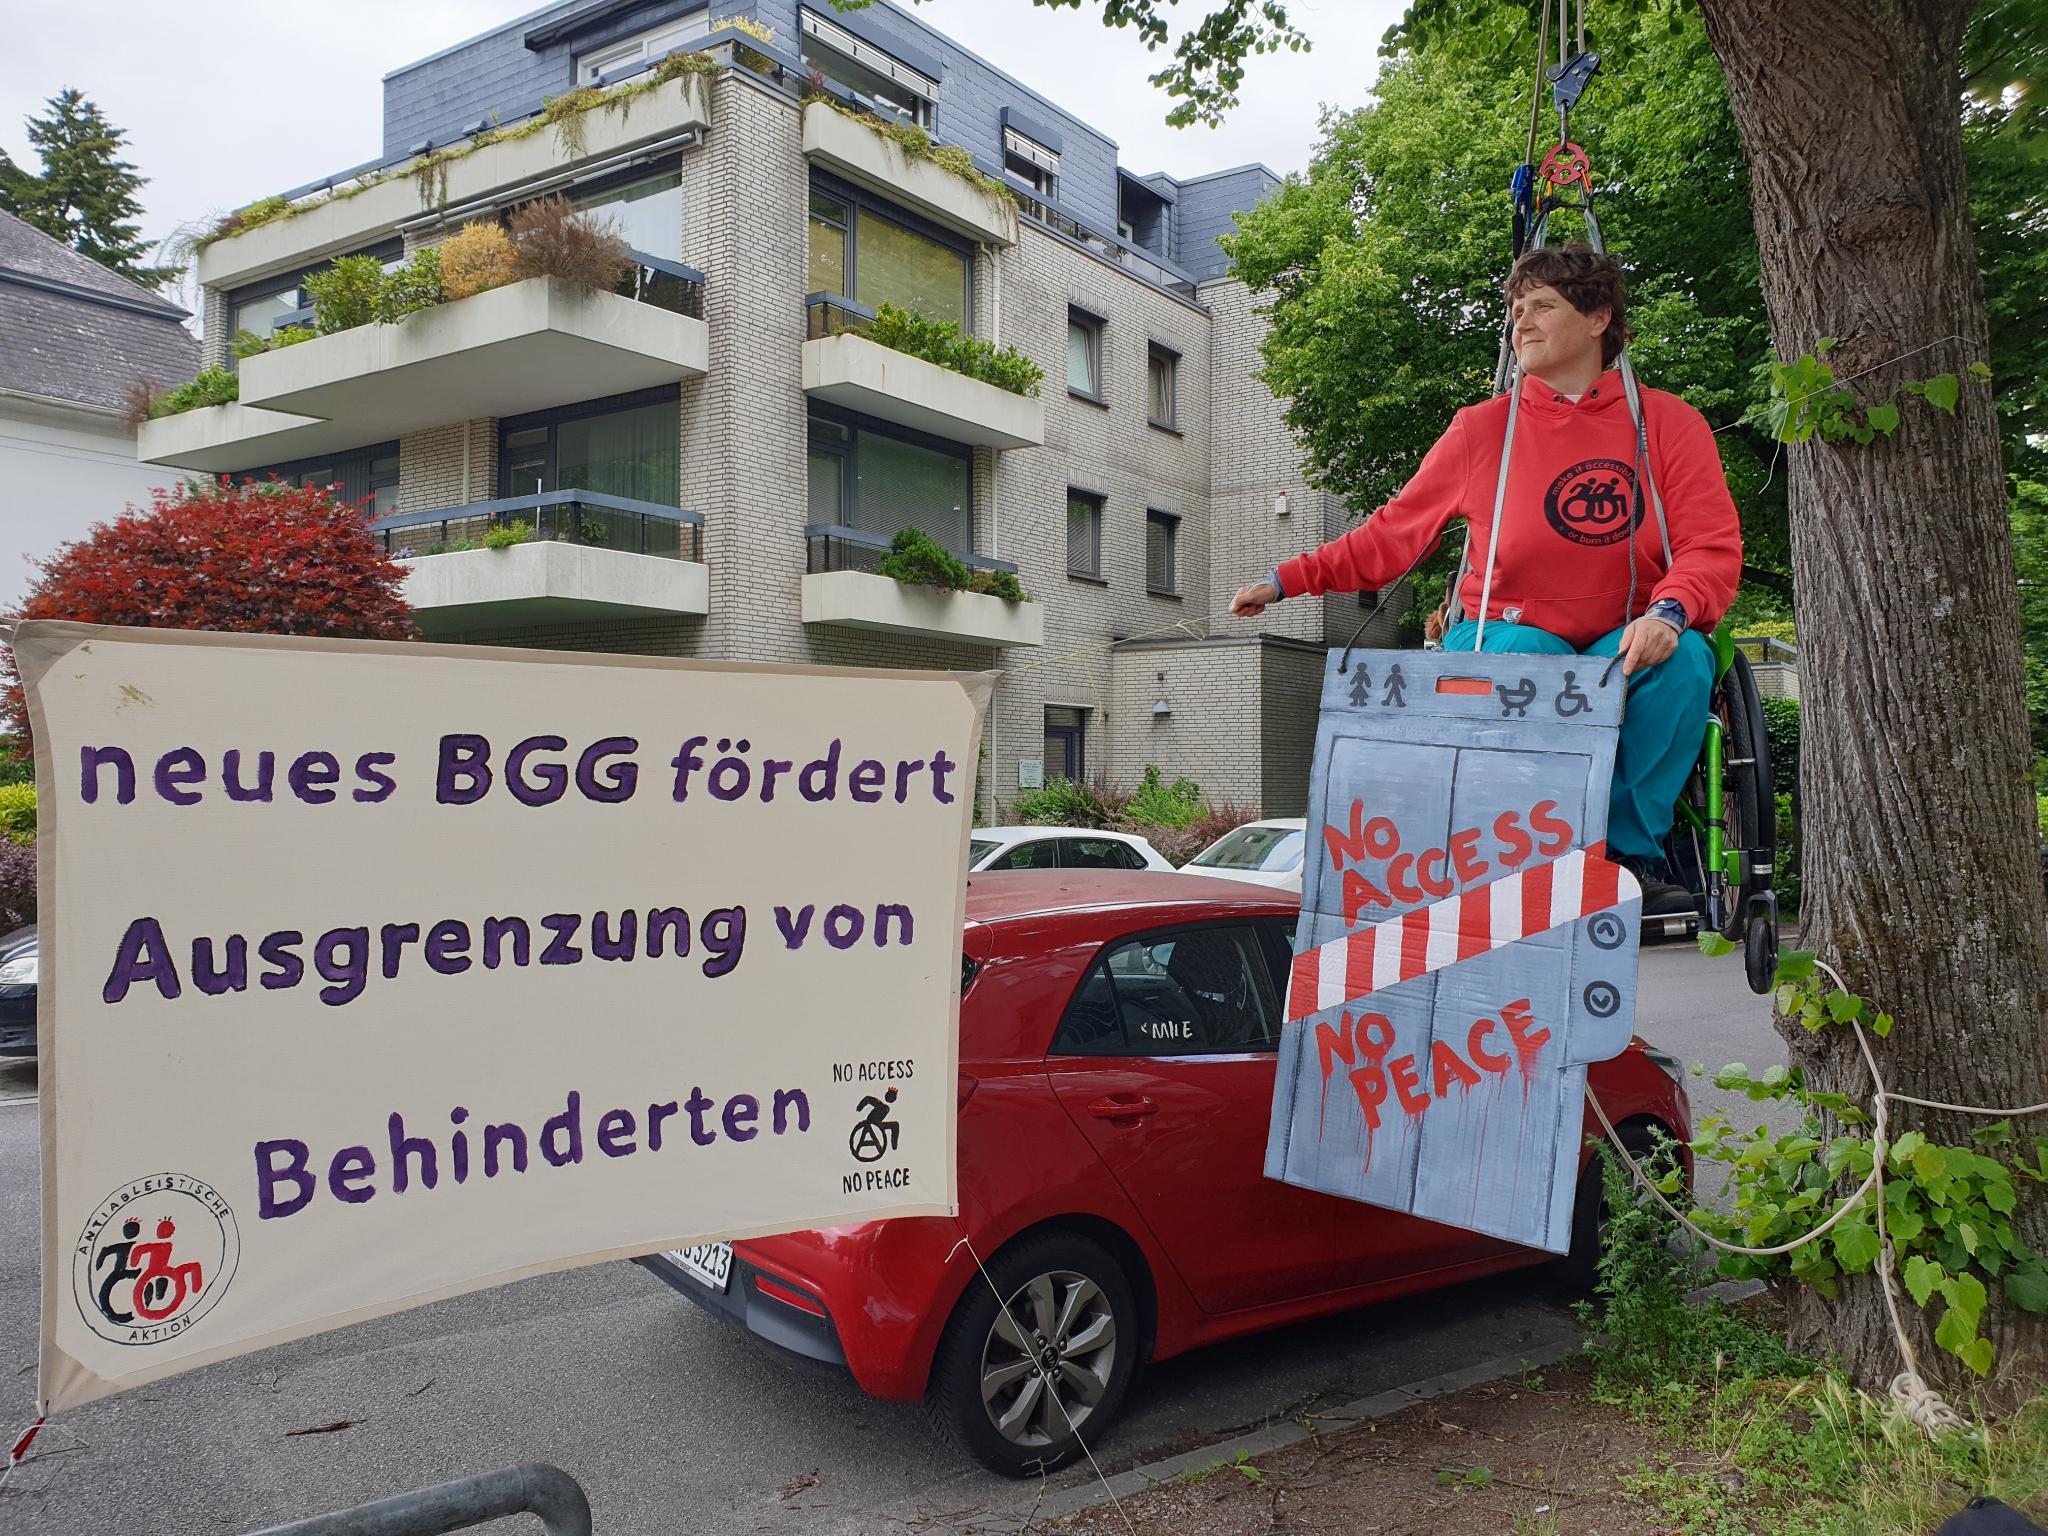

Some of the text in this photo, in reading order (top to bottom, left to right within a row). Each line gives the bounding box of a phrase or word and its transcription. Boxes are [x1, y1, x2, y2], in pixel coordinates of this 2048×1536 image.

[1552, 472, 1574, 496] make
[1574, 465, 1583, 474] it
[1568, 531, 1579, 539] or
[1580, 534, 1601, 545] burn
[1604, 535, 1610, 543] it
[80, 733, 956, 808] neues BGG fördert
[1323, 799, 1401, 872] NO
[1340, 800, 1573, 927] ACCESS
[102, 903, 914, 1007] Ausgrenzung von
[833, 1059, 914, 1083] NO ACCESS
[1315, 1011, 1396, 1080] NO
[1350, 998, 1551, 1130] PEACE
[254, 1086, 811, 1221] Behinderten
[843, 1167, 910, 1194] NO PEACE
[79, 1177, 229, 1255] ANTIABLEISTISCHE
[129, 1315, 190, 1341] AKTION
